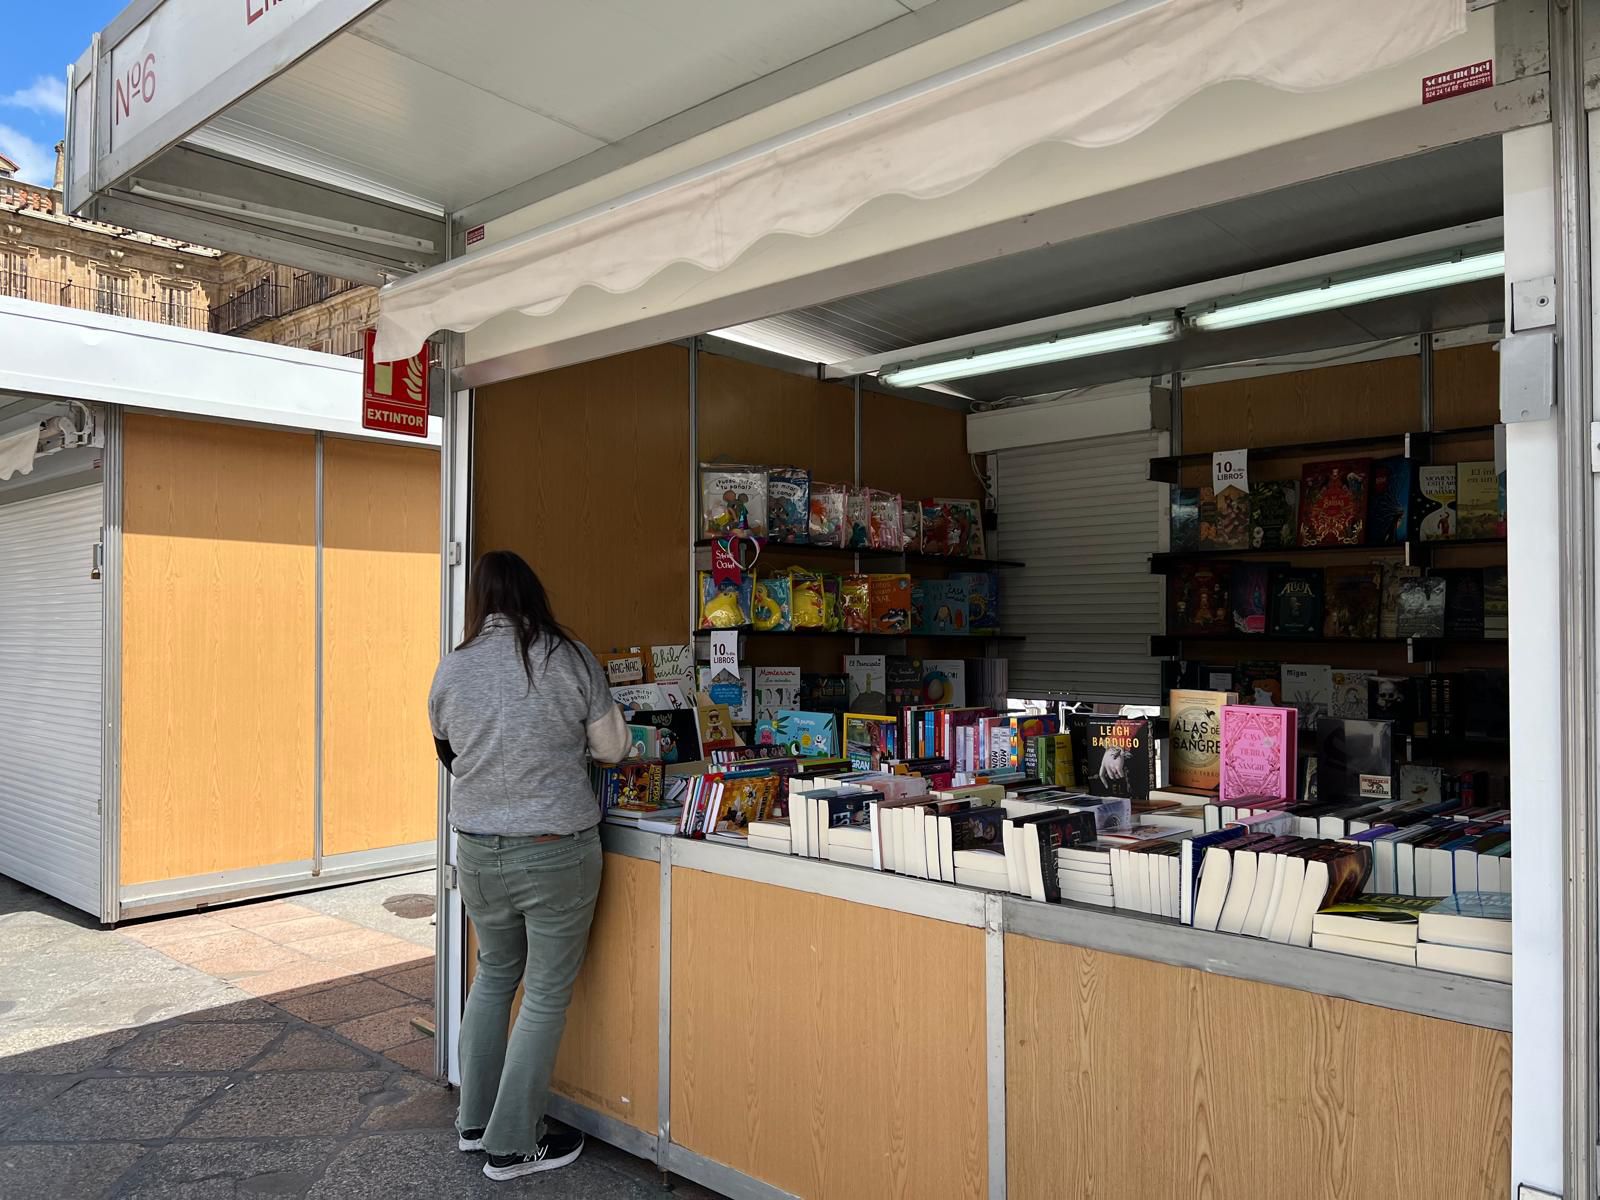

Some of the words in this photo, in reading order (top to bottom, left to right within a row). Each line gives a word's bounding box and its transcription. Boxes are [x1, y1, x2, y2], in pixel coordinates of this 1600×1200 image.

[1425, 61, 1490, 86] sonomobel
[116, 53, 156, 126] Nº6
[367, 408, 423, 427] EXTINTOR
[1216, 461, 1232, 473] 10
[1217, 472, 1244, 481] LIBROS
[713, 643, 726, 656] 10
[713, 656, 735, 664] LIBROS
[1100, 725, 1130, 737] LEIGH
[1174, 718, 1209, 734] ALAS
[1092, 736, 1140, 749] BARDUGO
[1173, 736, 1221, 754] SANGRE
